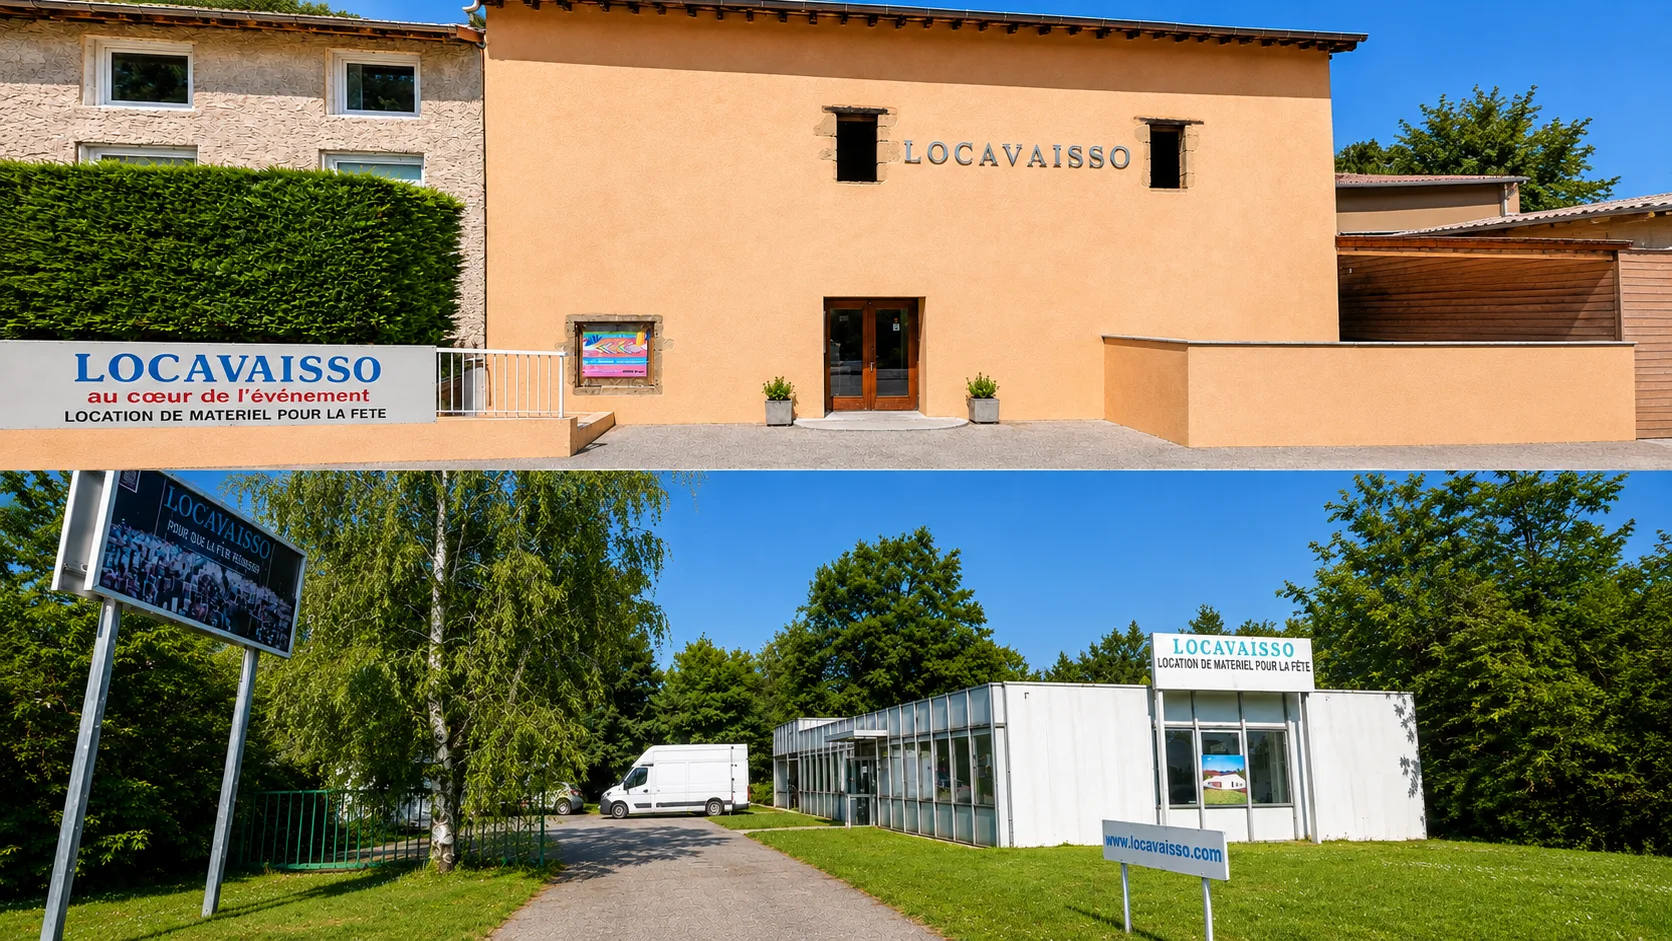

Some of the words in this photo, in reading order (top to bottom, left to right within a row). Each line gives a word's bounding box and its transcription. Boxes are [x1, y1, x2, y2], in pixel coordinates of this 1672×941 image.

[903, 140, 1131, 169] LOCAVAISSO
[74, 353, 381, 383] LOCAVAISSO
[87, 391, 118, 404] au
[127, 391, 193, 404] cœur
[200, 388, 229, 403] de
[64, 410, 153, 422] LOCATION
[160, 410, 183, 422] DE
[189, 409, 271, 421] MATERIEL
[278, 409, 321, 420] POUR
[327, 408, 346, 420] LA
[351, 408, 387, 419] FETE
[164, 485, 272, 559] LOCAVAISSO
[1173, 638, 1294, 657] LOCAVAISSO
[1157, 657, 1198, 669] LOCATION
[1200, 658, 1212, 669] DE
[1214, 659, 1254, 670] MATERIEL
[1255, 660, 1277, 671] POUR
[1279, 661, 1290, 671] LA
[1105, 835, 1222, 862] www.locavaisso.com
